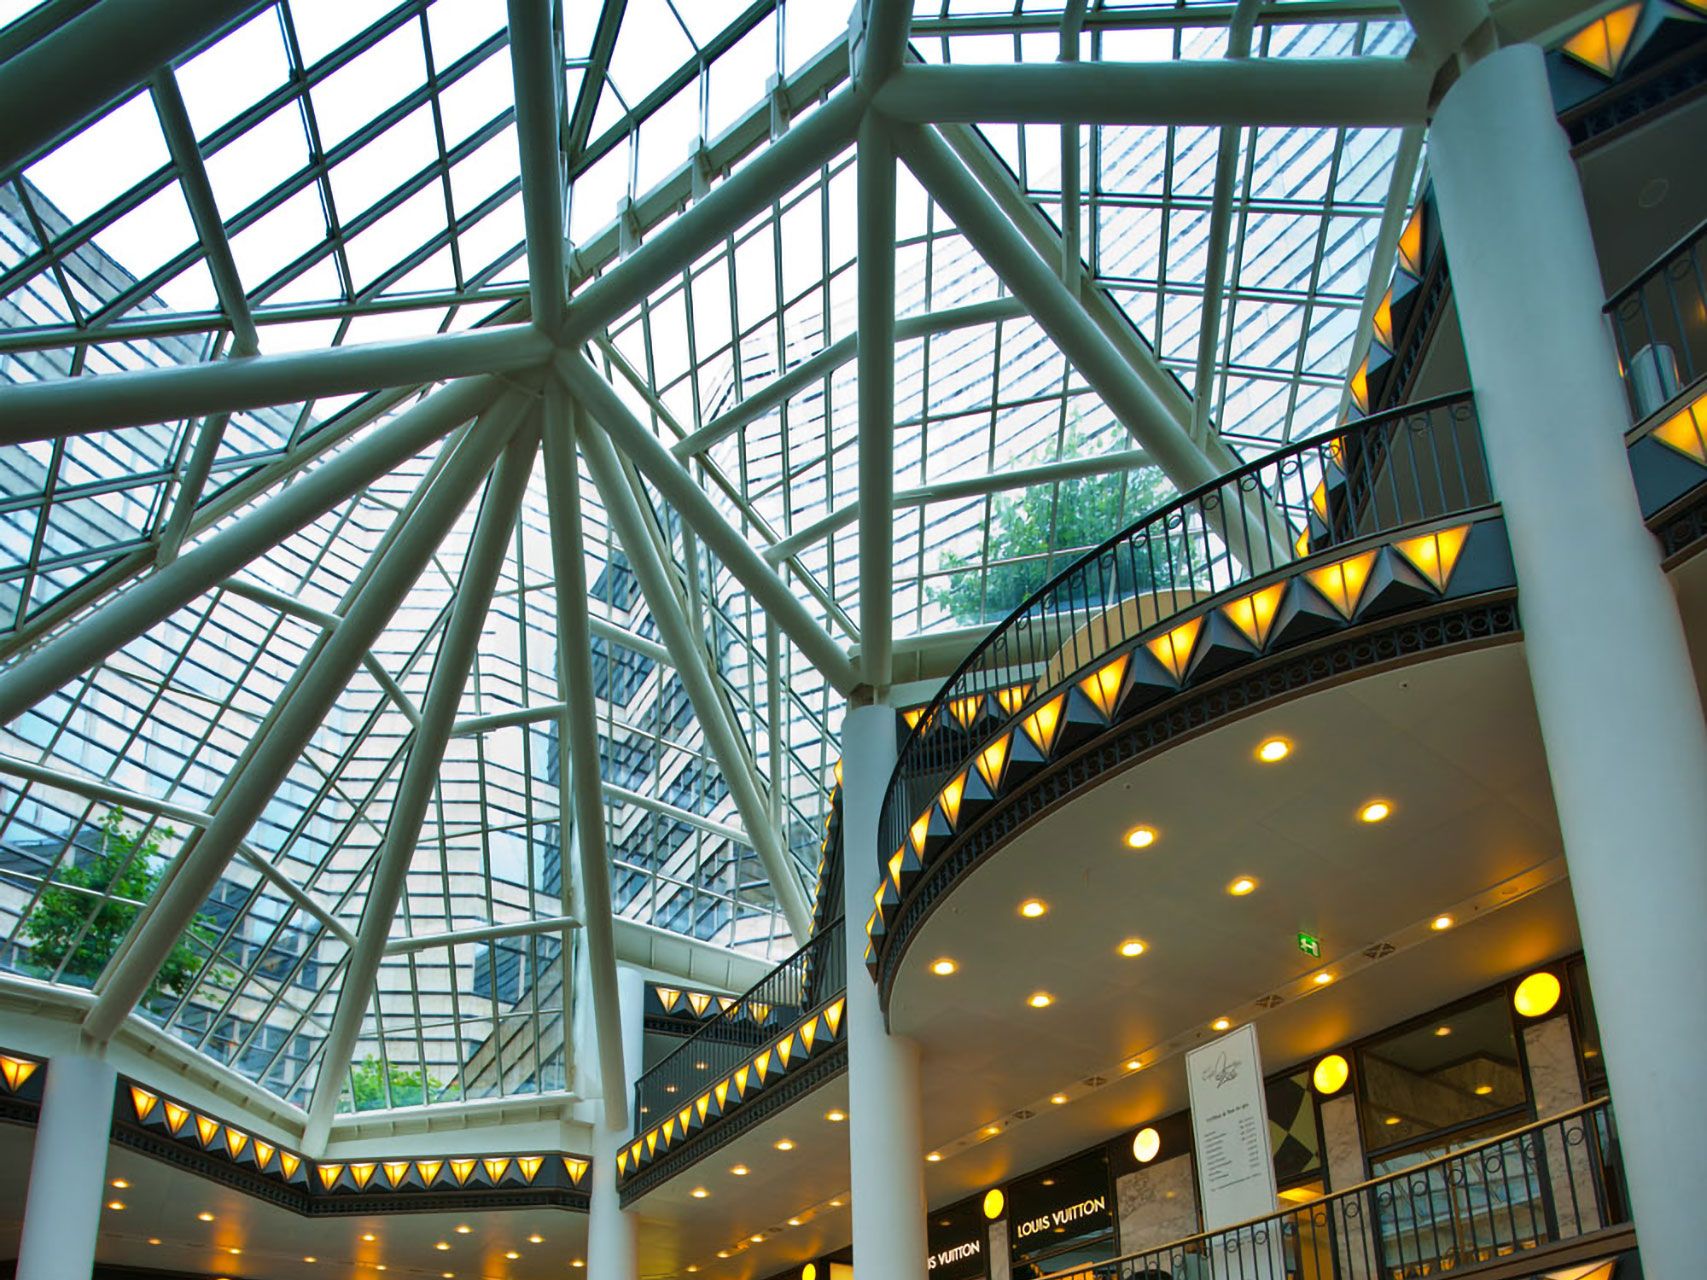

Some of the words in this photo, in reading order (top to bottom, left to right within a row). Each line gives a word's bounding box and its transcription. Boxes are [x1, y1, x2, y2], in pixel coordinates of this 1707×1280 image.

[1017, 1215, 1051, 1239] LOUIS
[1052, 1195, 1106, 1226] VUITTON
[937, 1240, 980, 1266] VUITTON
